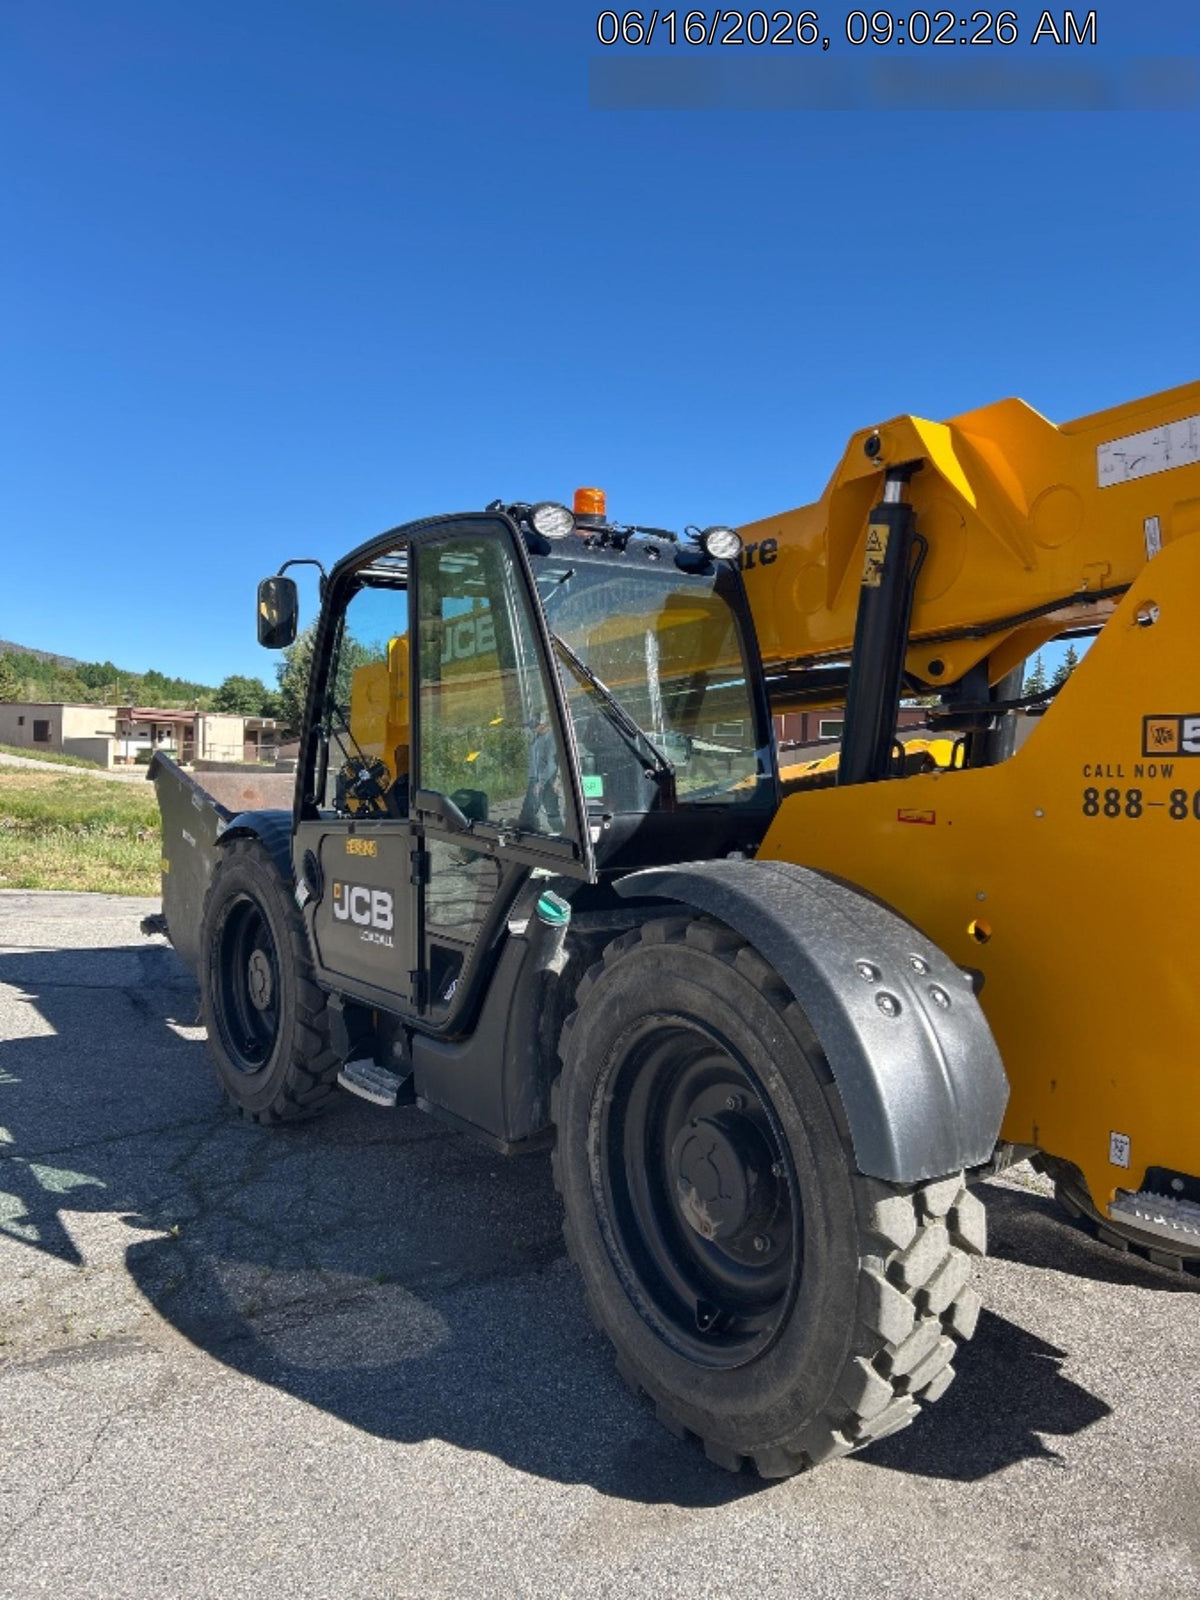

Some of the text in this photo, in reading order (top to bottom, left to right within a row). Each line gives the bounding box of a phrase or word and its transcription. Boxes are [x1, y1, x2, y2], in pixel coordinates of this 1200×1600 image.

[740, 537, 778, 570] re
[1083, 763, 1174, 778] CALL NOW
[333, 884, 394, 930] JCB
